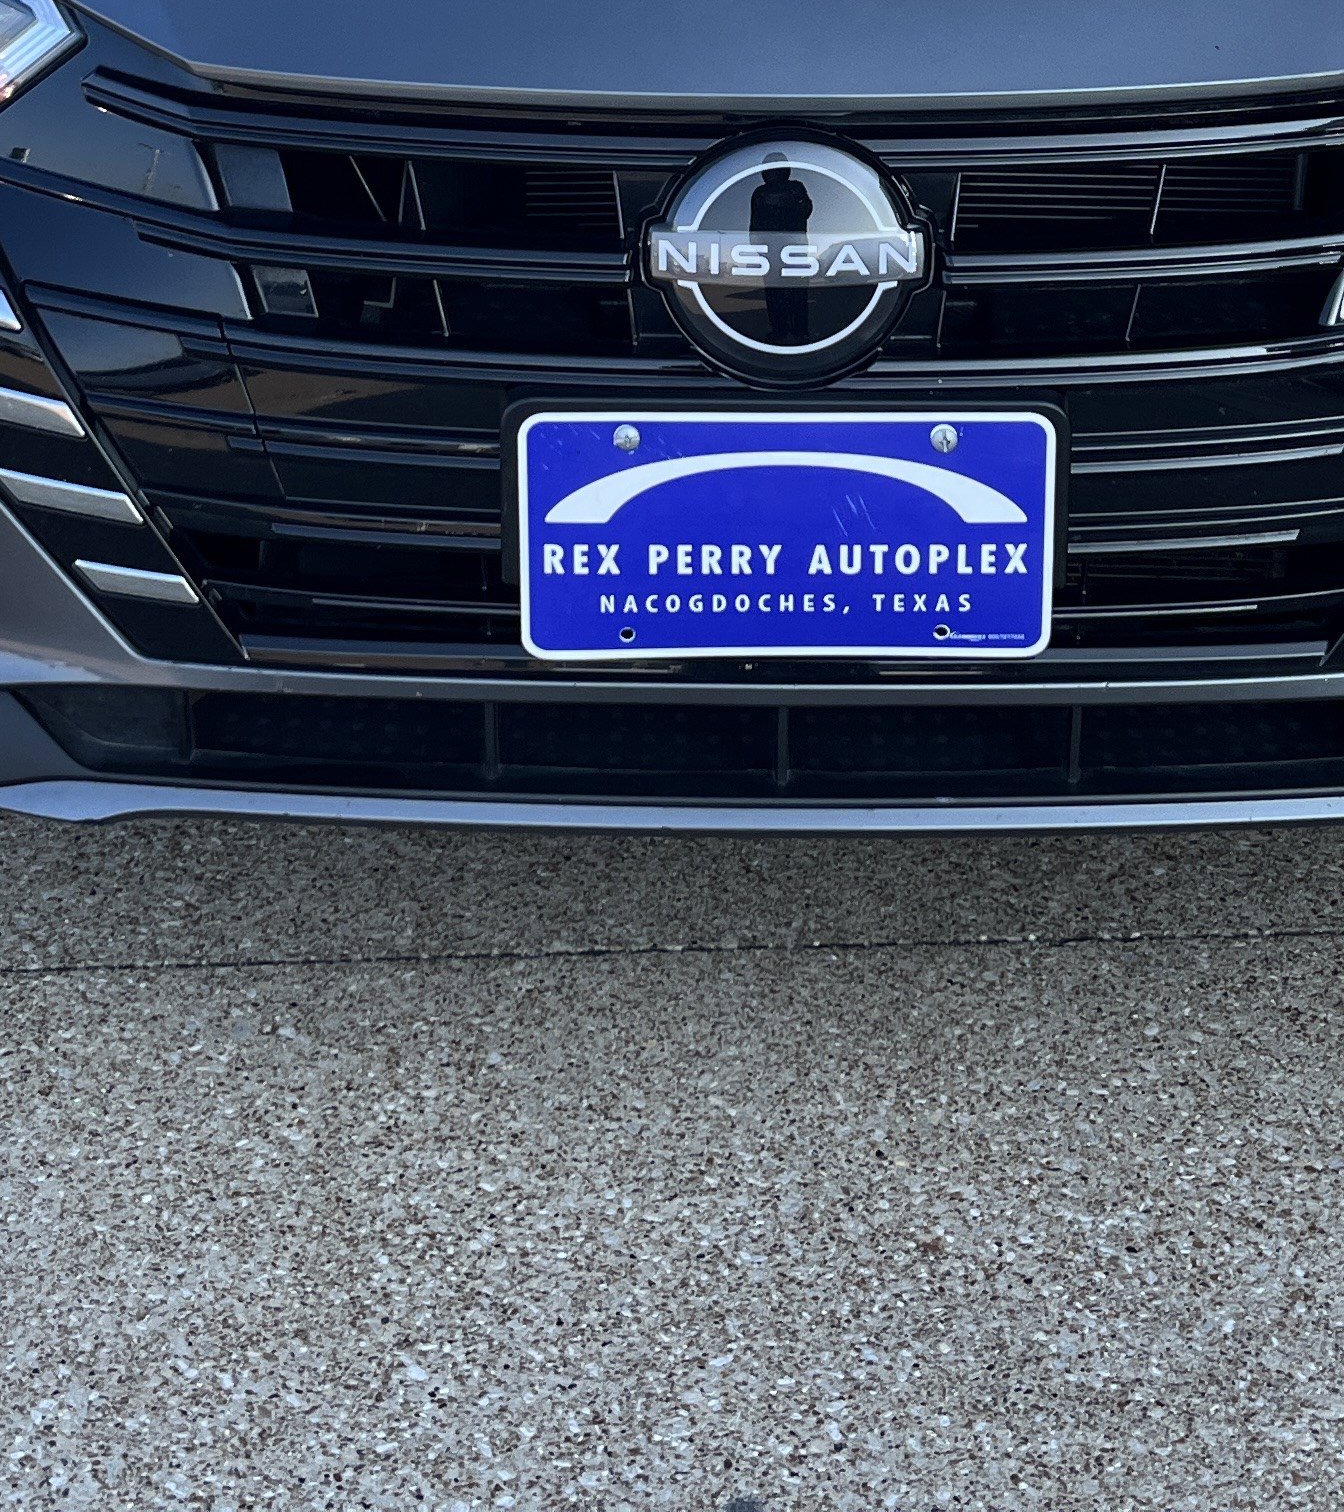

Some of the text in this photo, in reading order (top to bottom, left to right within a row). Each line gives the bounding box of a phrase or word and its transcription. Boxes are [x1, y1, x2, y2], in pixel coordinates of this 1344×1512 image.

[658, 238, 917, 277] NISSAN
[543, 543, 1028, 575] REX PERRY AUTOPLEX
[600, 593, 972, 615] NACOGDOCHES, TEXAS
